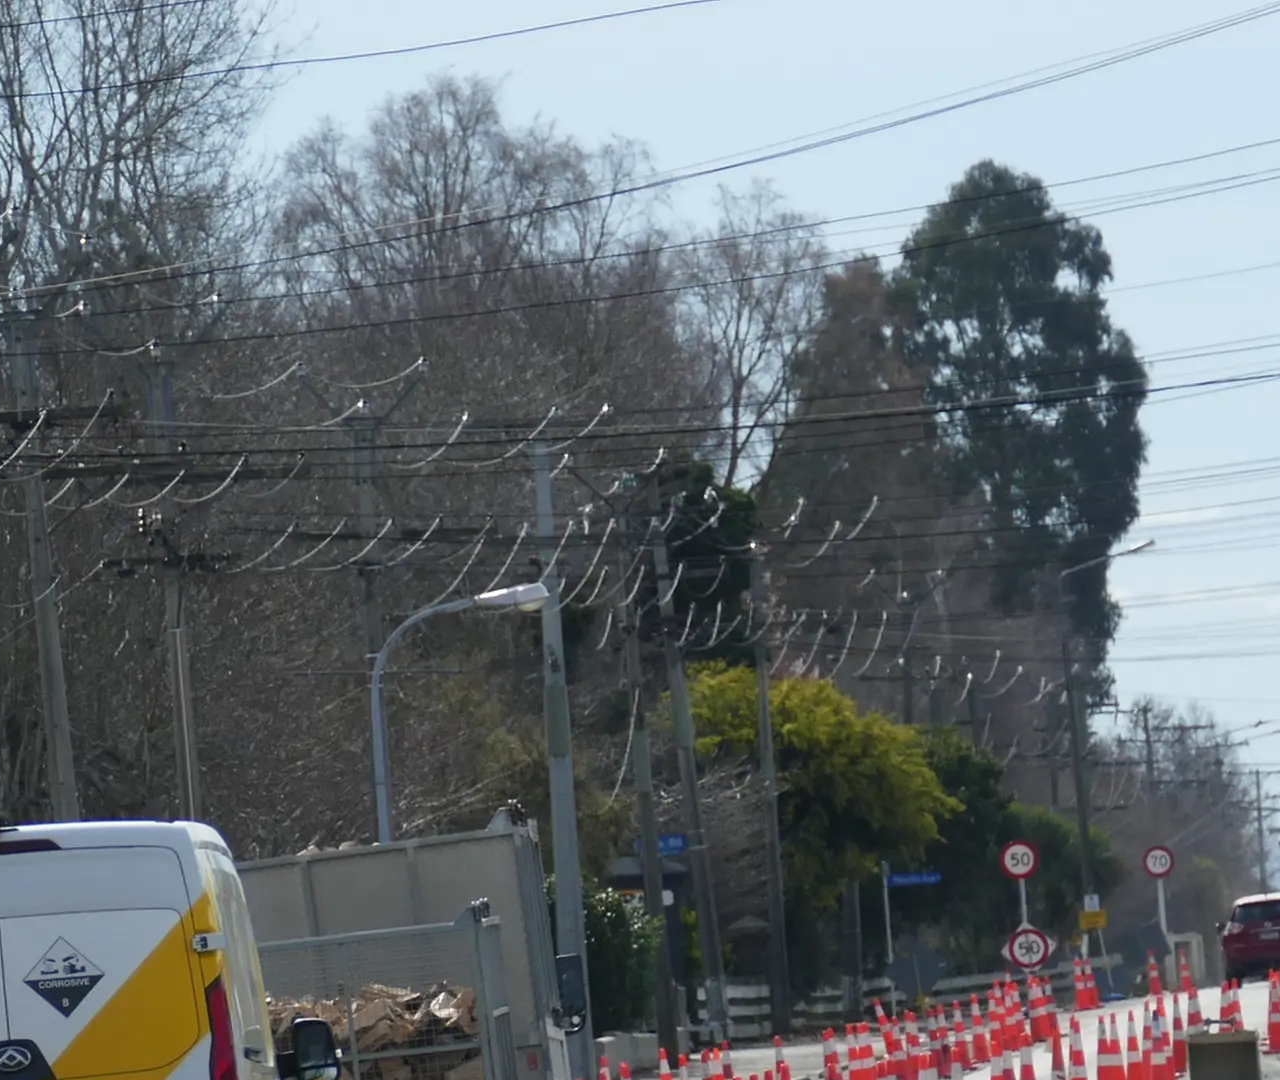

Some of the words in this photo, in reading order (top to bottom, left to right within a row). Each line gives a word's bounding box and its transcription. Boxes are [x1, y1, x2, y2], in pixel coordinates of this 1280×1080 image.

[1010, 852, 1031, 868] 50
[1150, 854, 1168, 869] 70
[1018, 938, 1041, 957] 50
[38, 977, 91, 989] CORROSIVE
[62, 998, 70, 1008] 8
